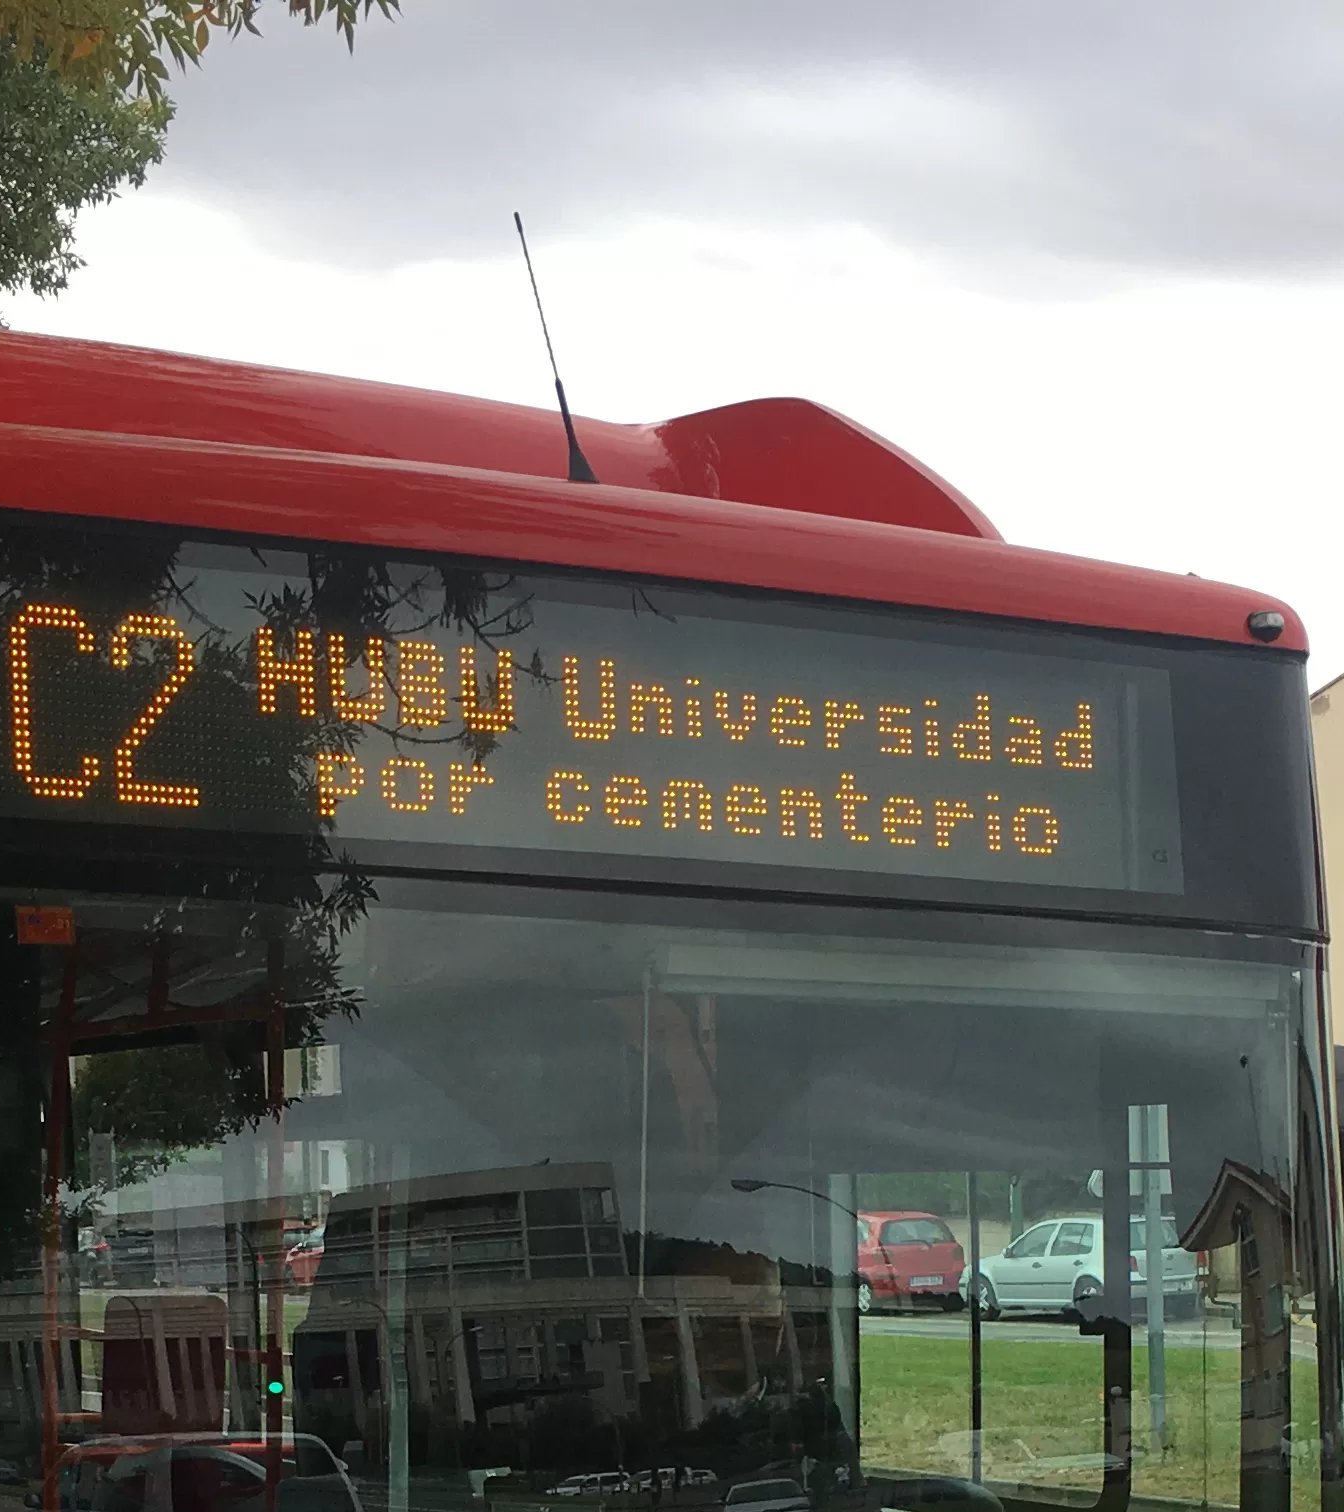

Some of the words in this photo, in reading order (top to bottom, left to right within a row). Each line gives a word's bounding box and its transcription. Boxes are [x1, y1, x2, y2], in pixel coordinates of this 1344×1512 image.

[10, 604, 200, 808] C2
[257, 627, 516, 733] HUBU
[563, 656, 1094, 769] Universidad
[317, 752, 496, 816] por
[545, 771, 1060, 855] cementerio
